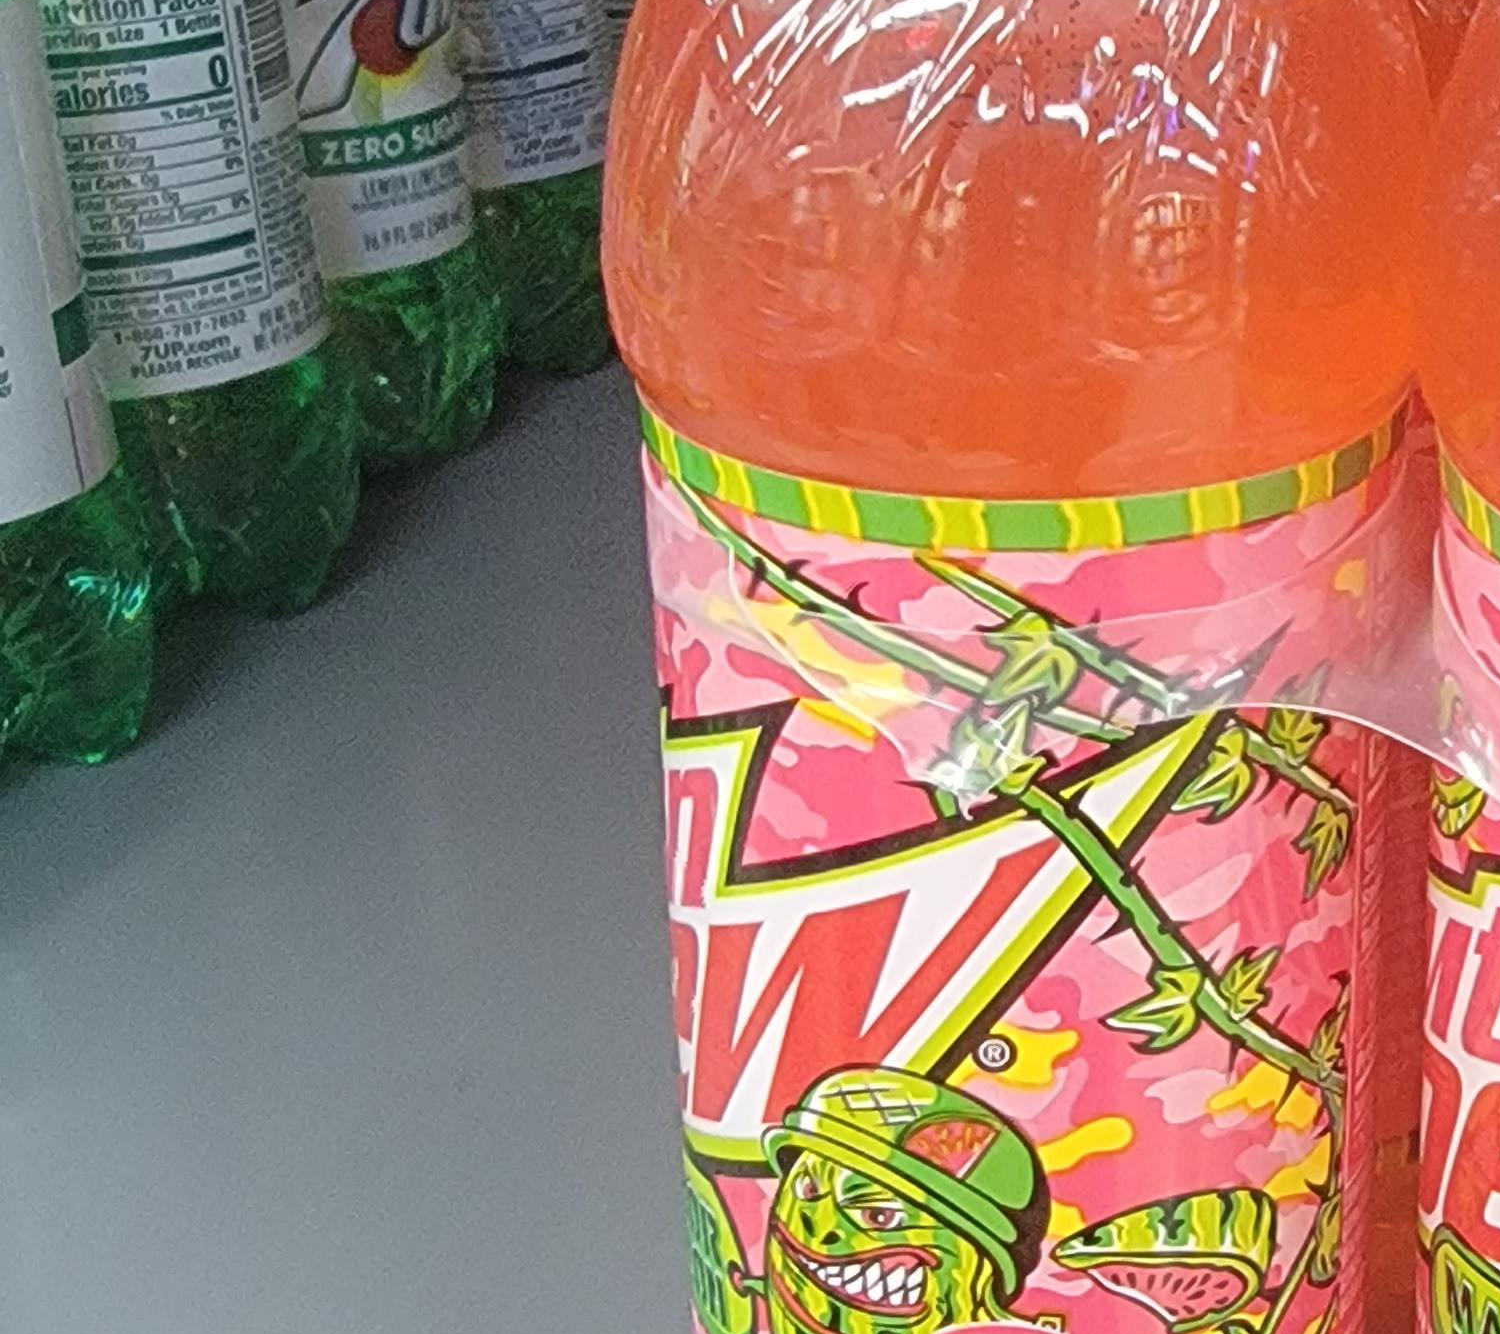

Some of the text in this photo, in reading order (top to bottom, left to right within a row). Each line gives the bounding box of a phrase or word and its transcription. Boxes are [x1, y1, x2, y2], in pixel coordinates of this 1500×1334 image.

[105, 26, 145, 46] size
[158, 20, 170, 38] 1
[174, 13, 222, 35] Bottle
[55, 53, 230, 111] alories 0
[321, 132, 406, 167] ZERO
[140, 334, 232, 361] 7UP.com
